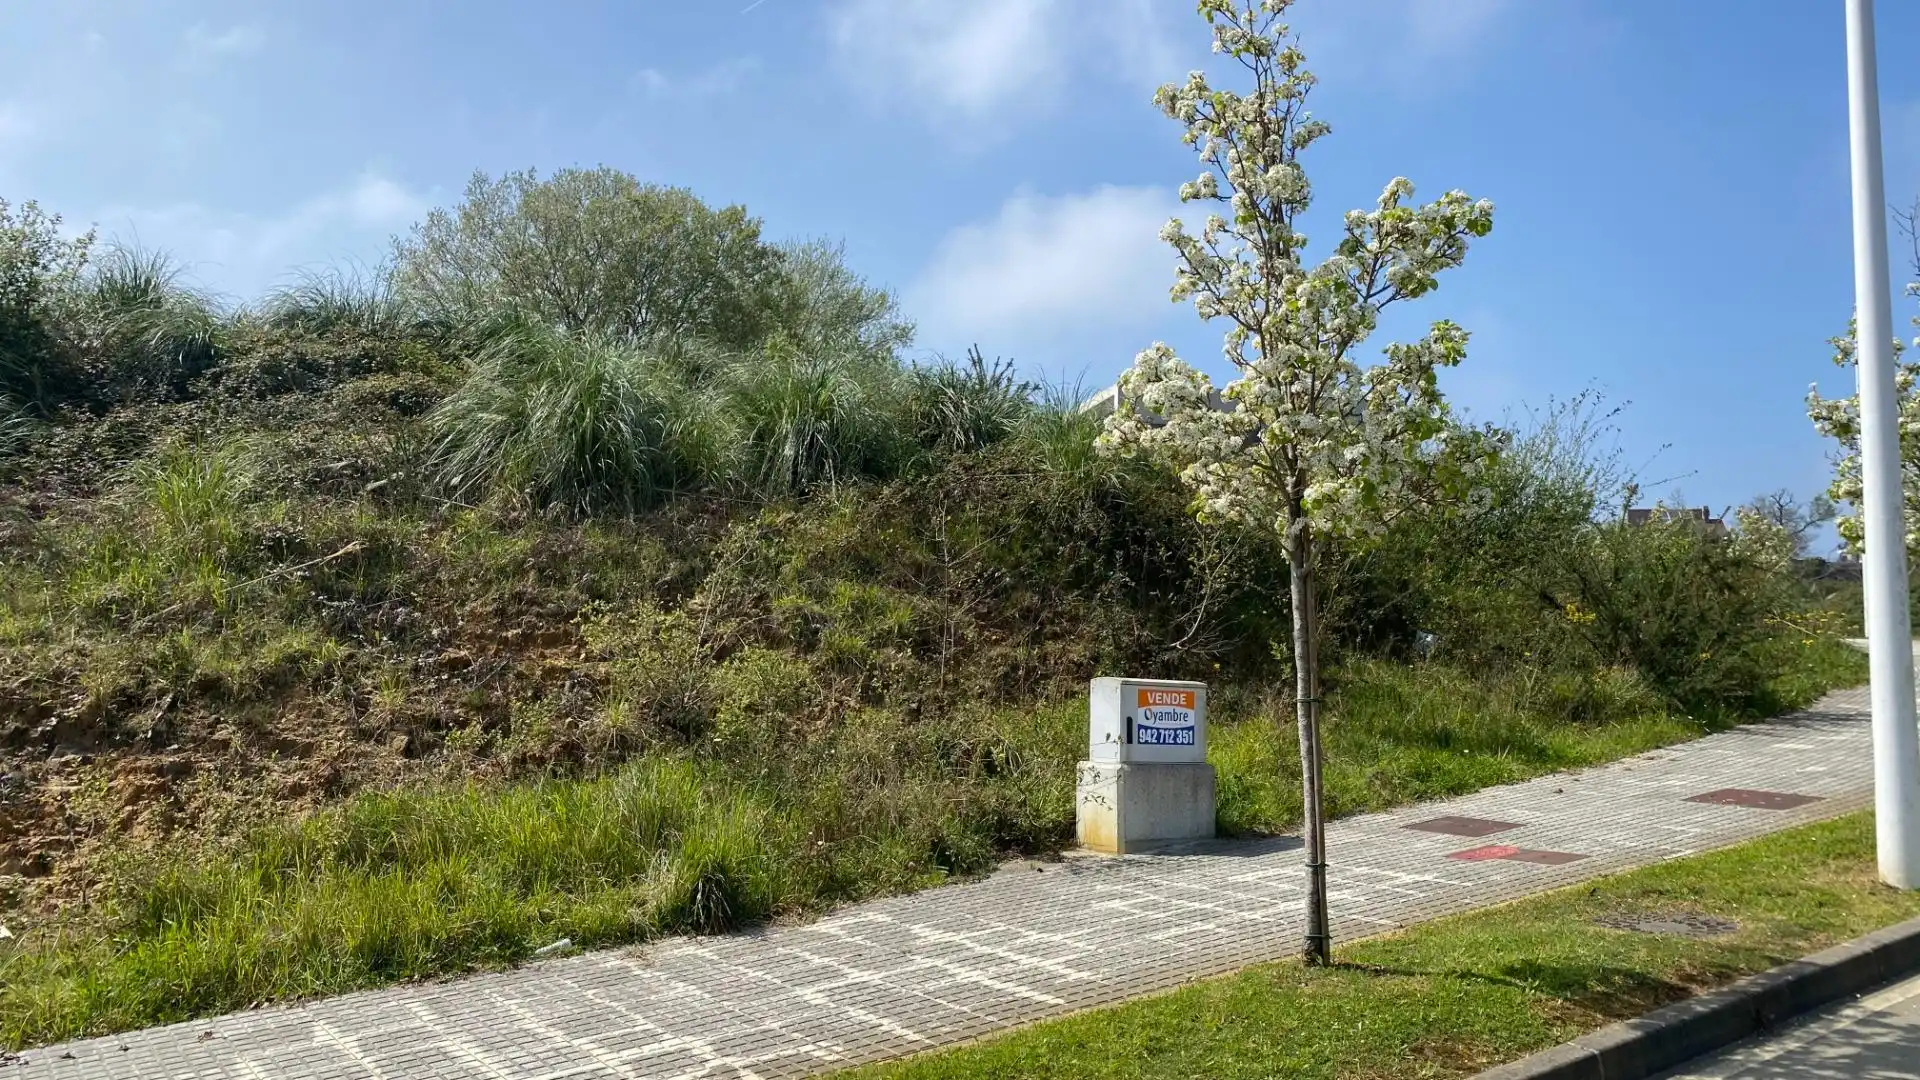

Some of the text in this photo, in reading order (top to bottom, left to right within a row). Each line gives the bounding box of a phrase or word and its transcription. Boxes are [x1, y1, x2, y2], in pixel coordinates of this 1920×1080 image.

[1147, 691, 1187, 704] VENDE
[1144, 708, 1189, 725] Oyambre
[1139, 729, 1193, 744] 942 712 351
